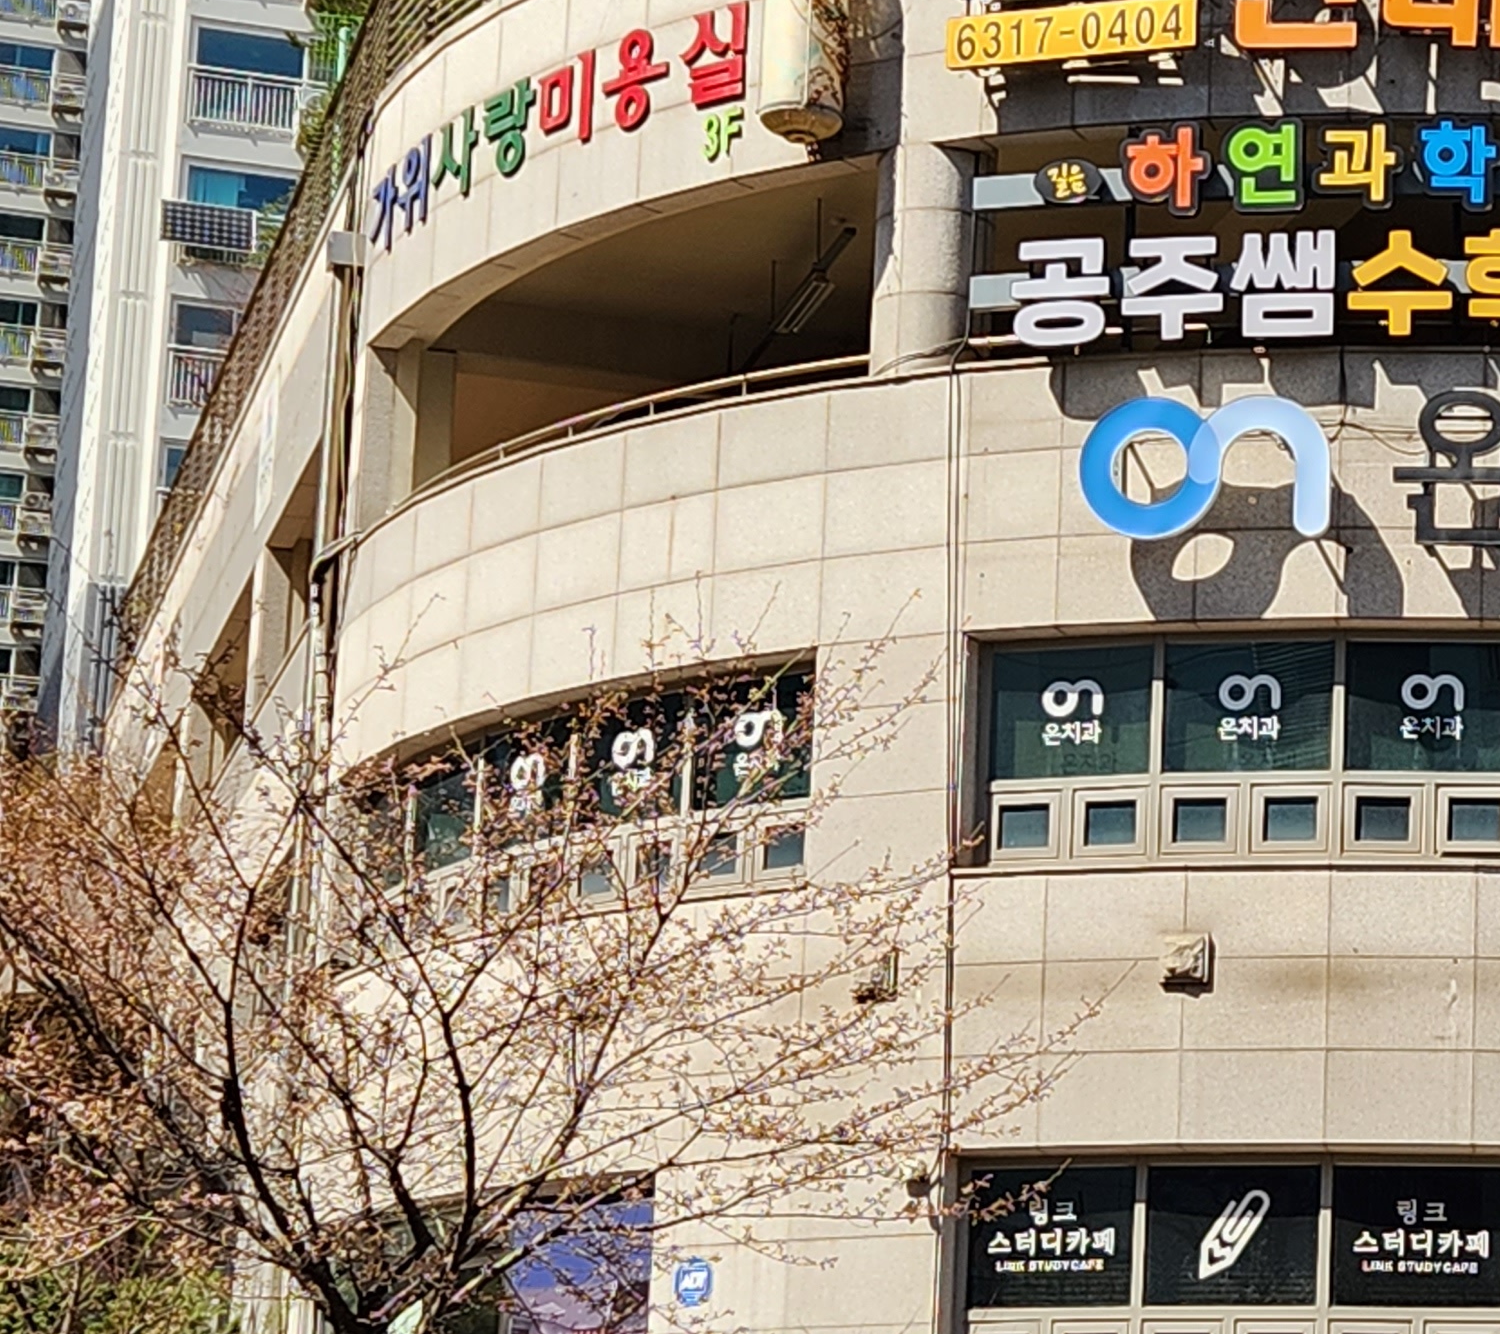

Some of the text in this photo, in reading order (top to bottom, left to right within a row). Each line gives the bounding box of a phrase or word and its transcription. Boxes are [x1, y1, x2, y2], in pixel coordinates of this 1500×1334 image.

[953, 4, 1186, 65] 6317-0404
[701, 105, 744, 163] 3F
[1126, 118, 1497, 209] 하연과학
[1040, 719, 1102, 747] 온치과
[1217, 714, 1282, 742] 온치과
[1399, 714, 1465, 742] 온치과
[1029, 1199, 1078, 1227] 링크
[1396, 1198, 1448, 1226] 링크
[987, 1227, 1116, 1256] 스터디카페
[1352, 1227, 1490, 1260] 스터디카페
